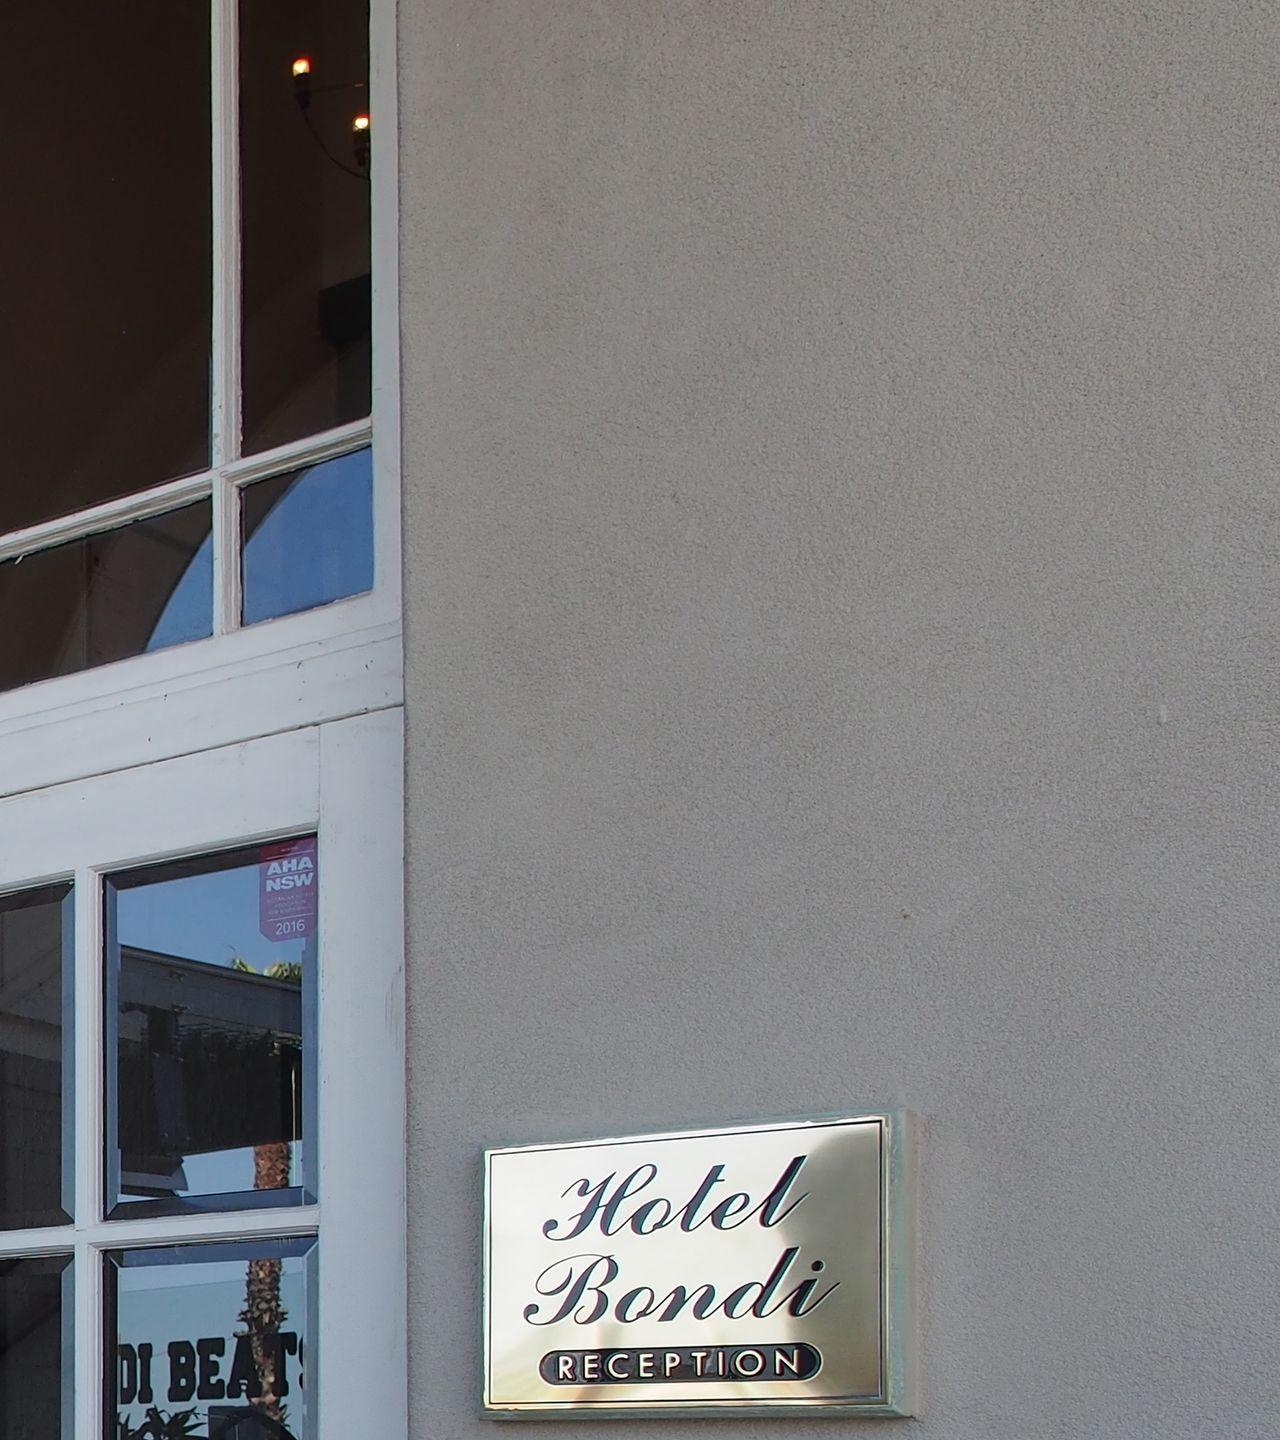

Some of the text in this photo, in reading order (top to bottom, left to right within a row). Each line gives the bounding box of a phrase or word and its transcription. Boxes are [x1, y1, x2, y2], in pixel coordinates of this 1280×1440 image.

[267, 856, 313, 875] AHA
[266, 873, 314, 892] NSW
[275, 919, 306, 936] 2016
[542, 1154, 811, 1243] Hotel
[523, 1246, 842, 1328] Bondi
[556, 1347, 802, 1382] RECEPTION
